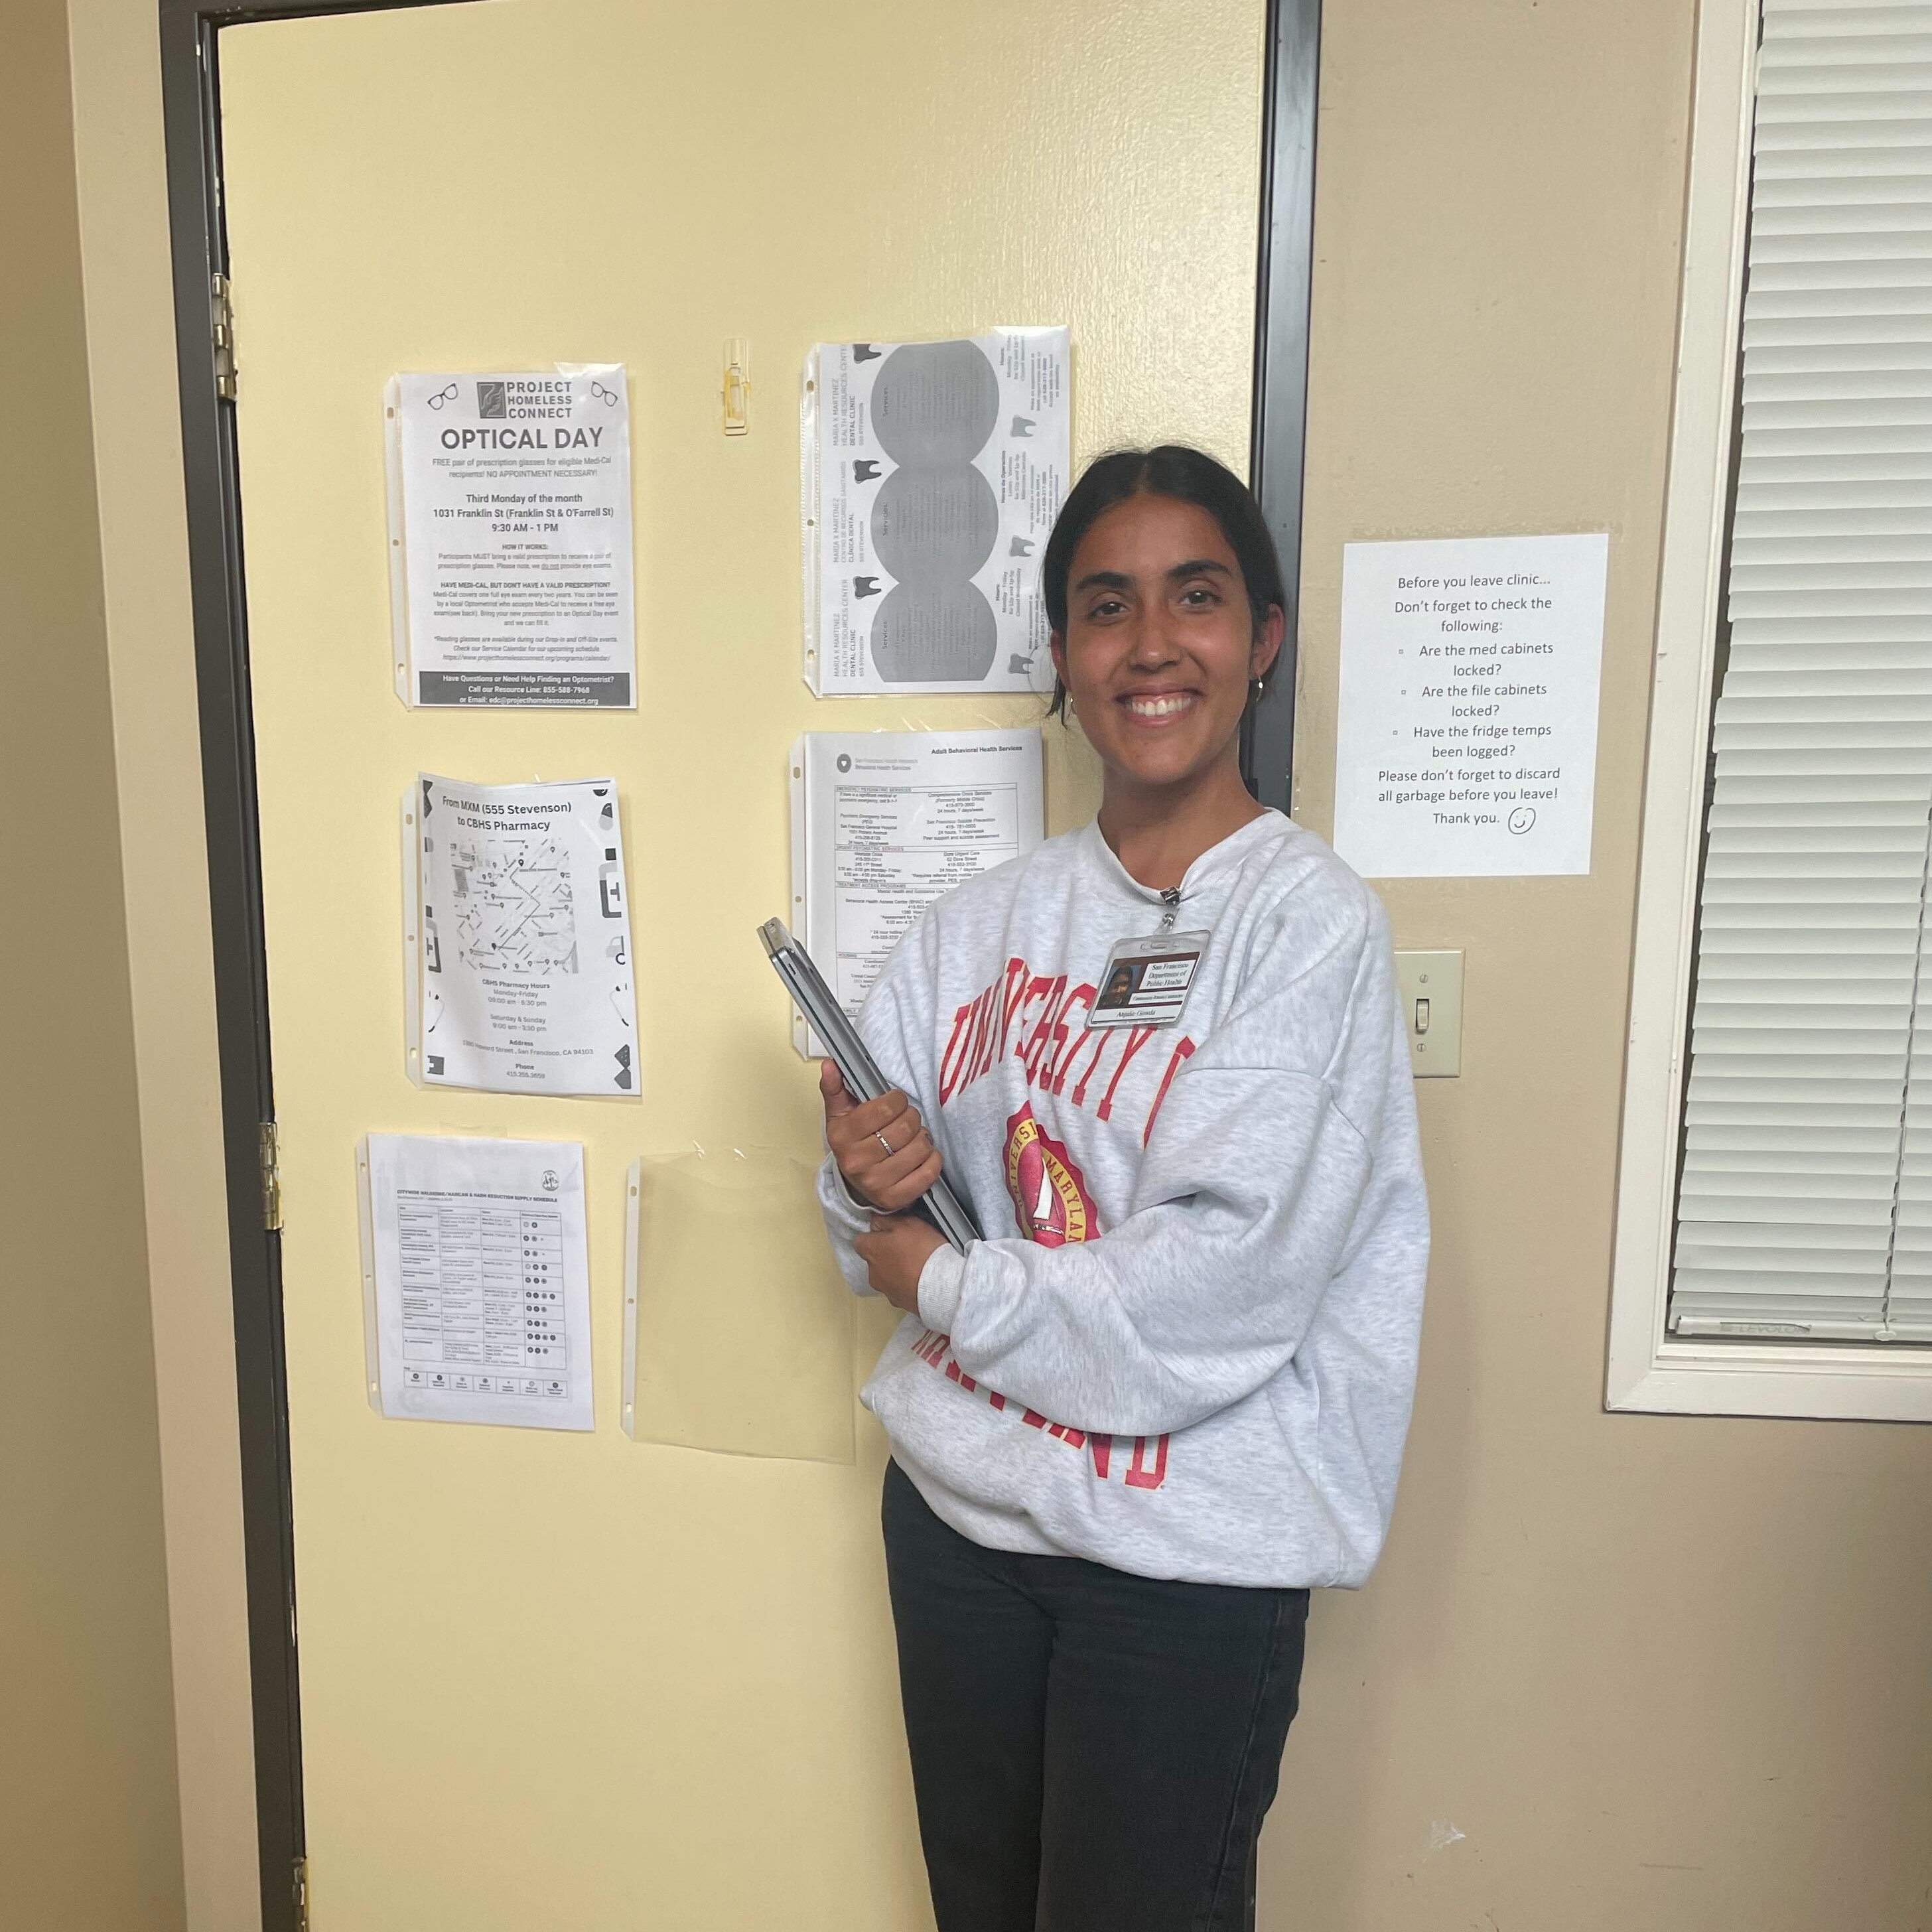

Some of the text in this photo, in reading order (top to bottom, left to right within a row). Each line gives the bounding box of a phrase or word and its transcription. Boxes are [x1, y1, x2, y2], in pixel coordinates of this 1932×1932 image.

[507, 381, 573, 393] PROJECT
[508, 395, 573, 405] HOMELESS
[508, 407, 573, 419] CONNECT
[441, 427, 602, 449] OPTICAL DAY
[465, 494, 488, 502] Third
[491, 494, 525, 504] Monday
[527, 494, 537, 502] of
[539, 494, 553, 502] the
[457, 508, 492, 517] Franklin
[506, 508, 543, 519] (Franklin
[565, 508, 600, 516] O'Farrell
[602, 508, 613, 517] St)
[1399, 573, 1550, 589] Before you leave clinic...
[1395, 597, 1551, 614] Don't forget to check the
[1441, 620, 1502, 634] following:
[1419, 642, 1553, 656] Are the med cabinets
[1454, 664, 1501, 675] locked?
[1421, 683, 1547, 697] Are the file cabinets
[1452, 705, 1499, 716] locked?
[1414, 724, 1551, 738] Have the fridge temps
[1432, 744, 1515, 759] been logged?
[1379, 768, 1560, 782] Please don't forget to discard
[1379, 788, 1557, 803] all garbage before you leave!
[443, 796, 571, 815] From MXM (555 Stevenson)
[458, 817, 551, 831] to CBHS Pharmacy
[1433, 813, 1499, 825] Thank you.
[499, 981, 529, 990] Pharmacy
